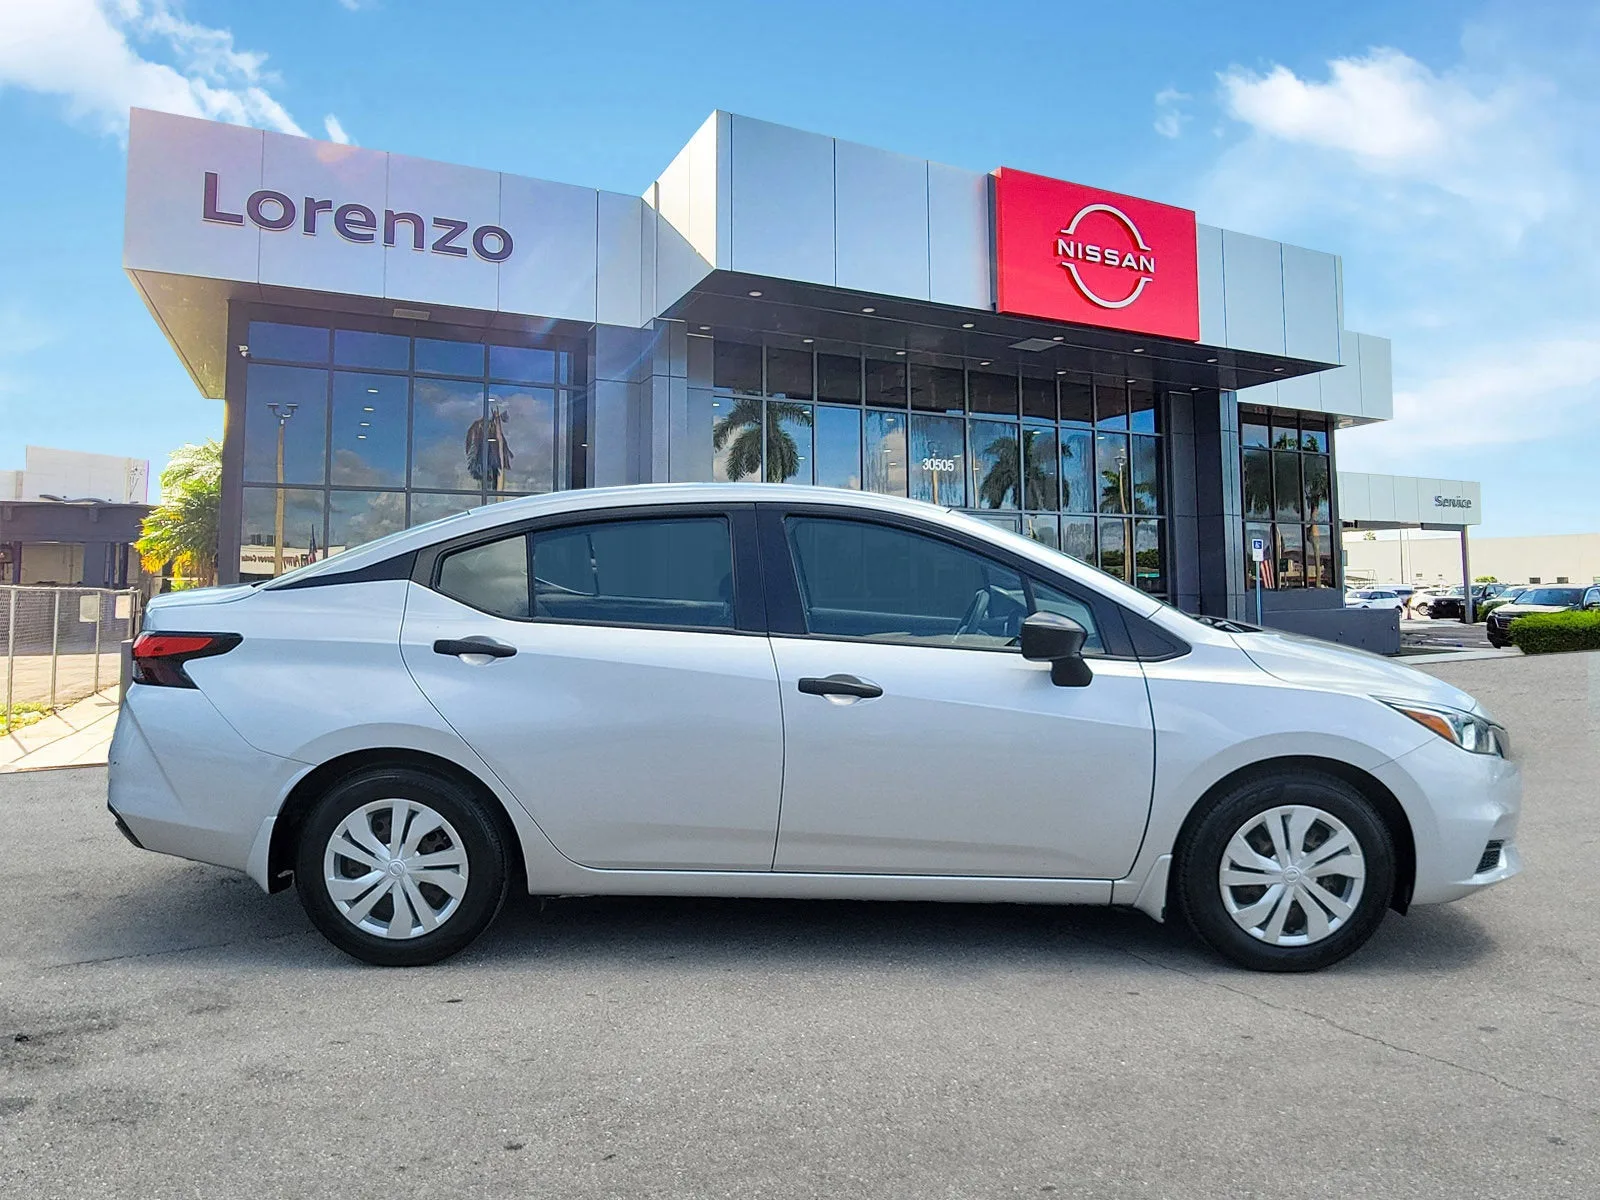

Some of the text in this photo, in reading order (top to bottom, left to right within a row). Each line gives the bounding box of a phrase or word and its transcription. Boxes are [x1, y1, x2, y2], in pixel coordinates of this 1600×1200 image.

[202, 170, 515, 263] Lorenzo
[1057, 238, 1156, 273] NISSAN
[922, 458, 955, 471] 30505
[1434, 495, 1472, 508] Service
